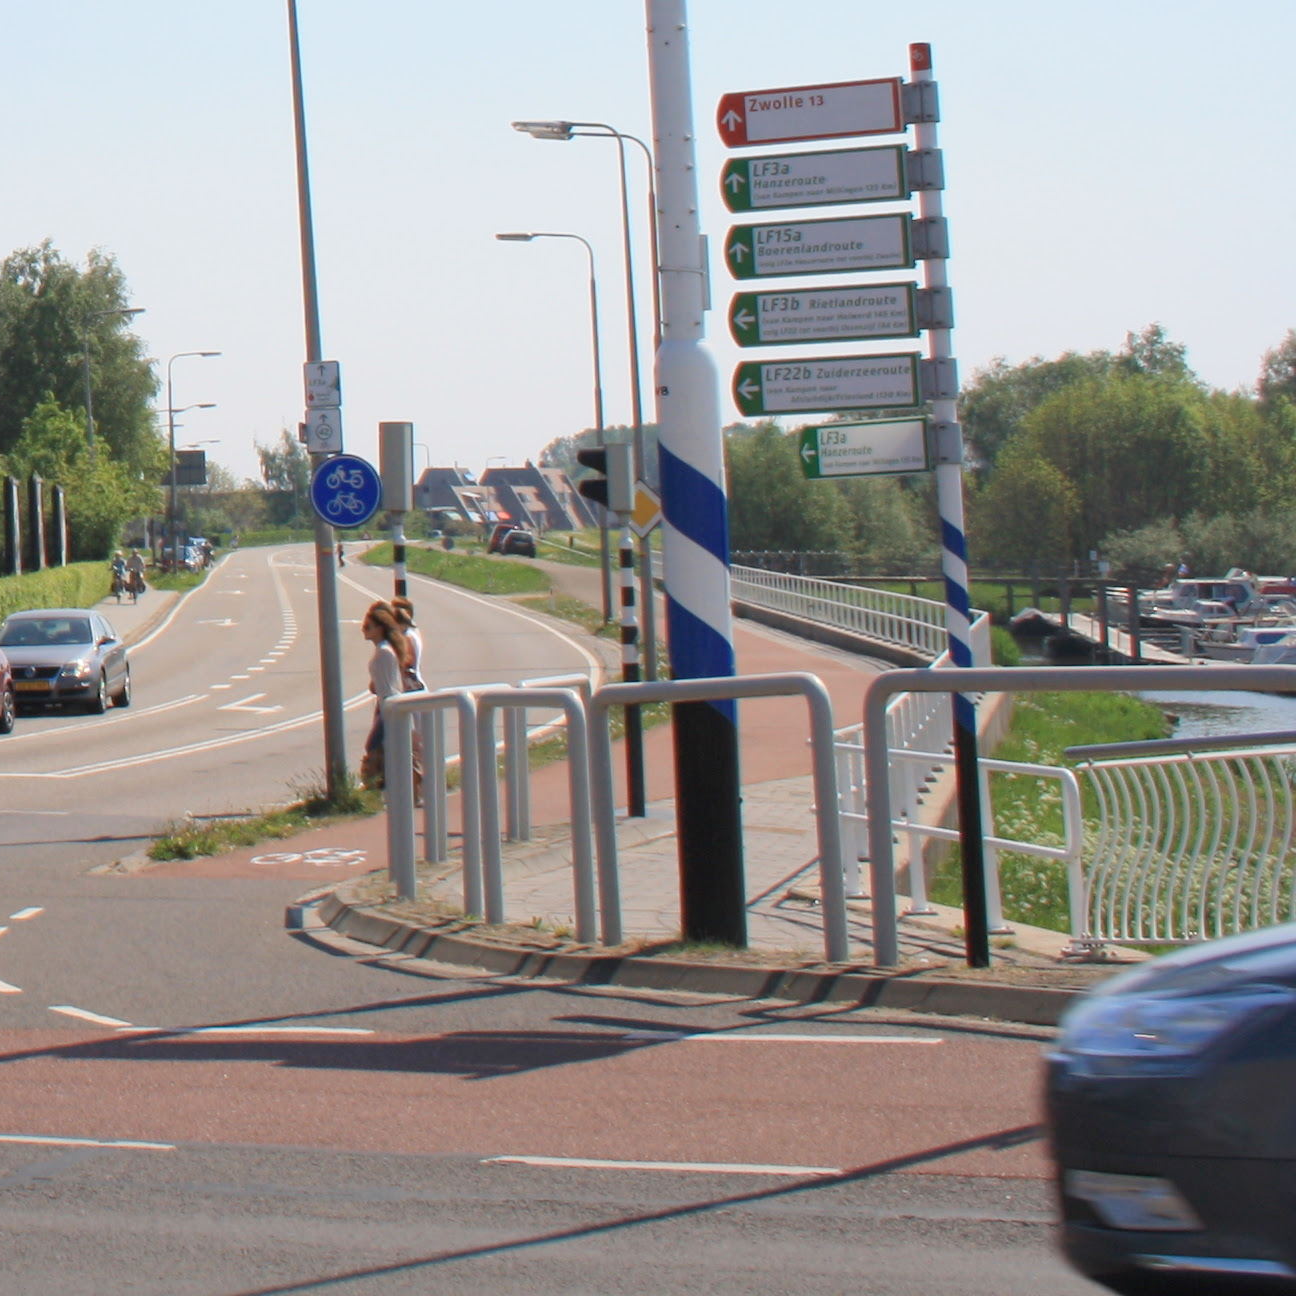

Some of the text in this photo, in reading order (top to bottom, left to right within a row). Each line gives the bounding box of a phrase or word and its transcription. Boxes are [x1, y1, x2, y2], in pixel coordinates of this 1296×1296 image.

[748, 95, 824, 112] Zwolle 13
[752, 162, 790, 177] LF3a
[753, 175, 826, 190] Hanzeroute
[756, 229, 802, 244] LF15a
[757, 241, 864, 257] Boerenlandroute
[761, 296, 898, 312] LF3b Rietlandroute
[765, 364, 912, 382] LF22b Zuiderzeeroute
[820, 431, 847, 446] LF3a
[820, 445, 873, 457] Hanzeroute
